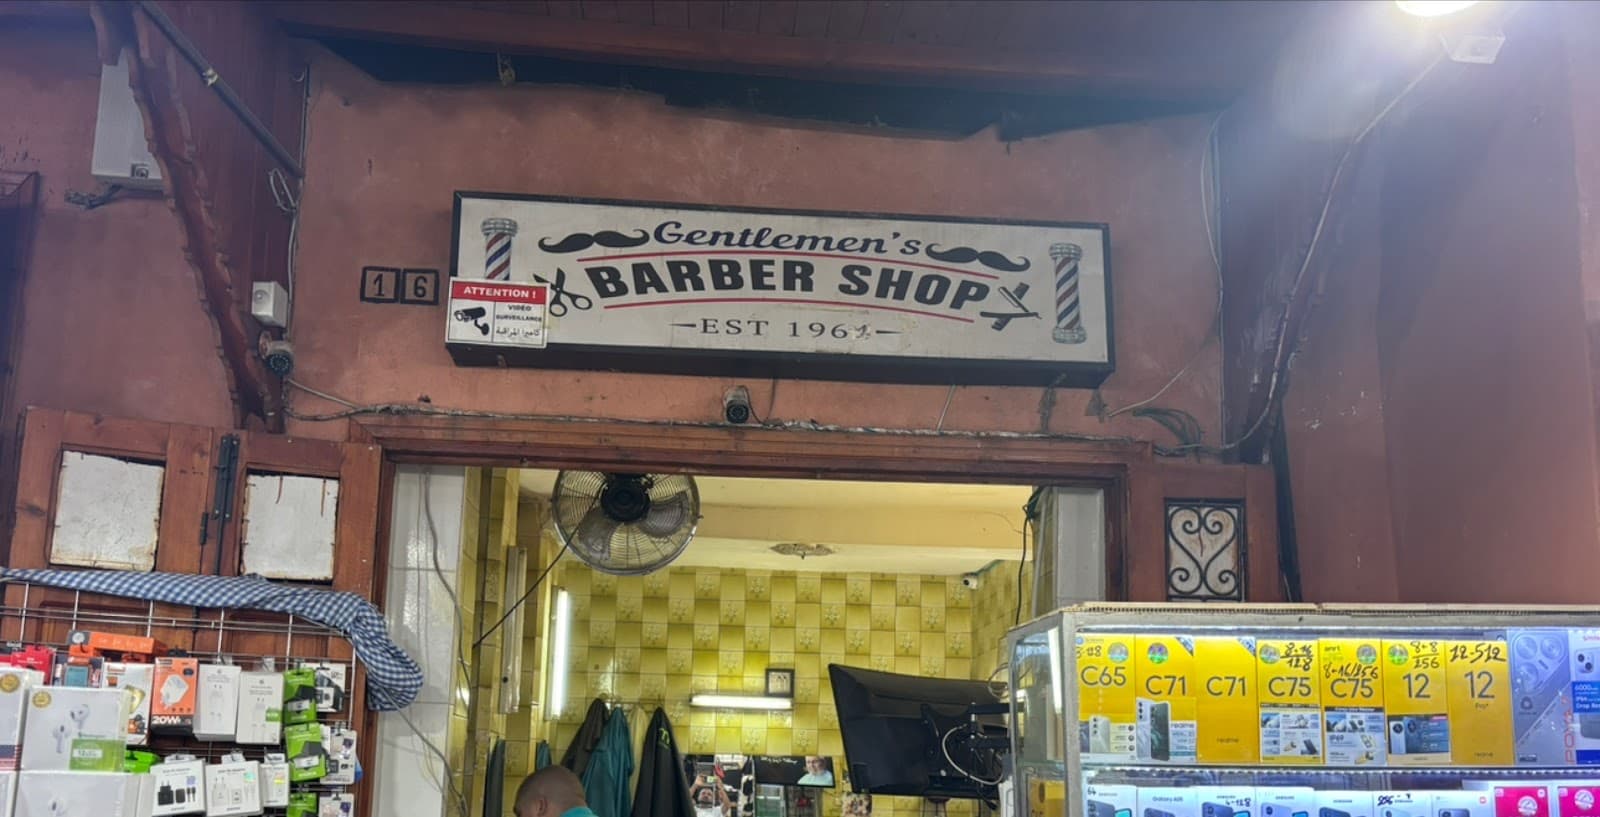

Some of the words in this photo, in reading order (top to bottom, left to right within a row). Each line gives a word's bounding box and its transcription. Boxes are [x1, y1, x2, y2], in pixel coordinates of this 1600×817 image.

[653, 220, 921, 255] Gentlemen's
[463, 286, 529, 298] ATTENTION
[585, 258, 815, 299] BARBER
[837, 264, 990, 310] SHOP
[701, 318, 769, 336] EST
[1081, 665, 1126, 686] C65
[1145, 675, 1187, 696] C71
[1402, 672, 1431, 698] 12
[1464, 670, 1495, 698] 12
[1206, 676, 1247, 697] C71
[1268, 676, 1312, 697] C75
[1330, 678, 1374, 698] C75
